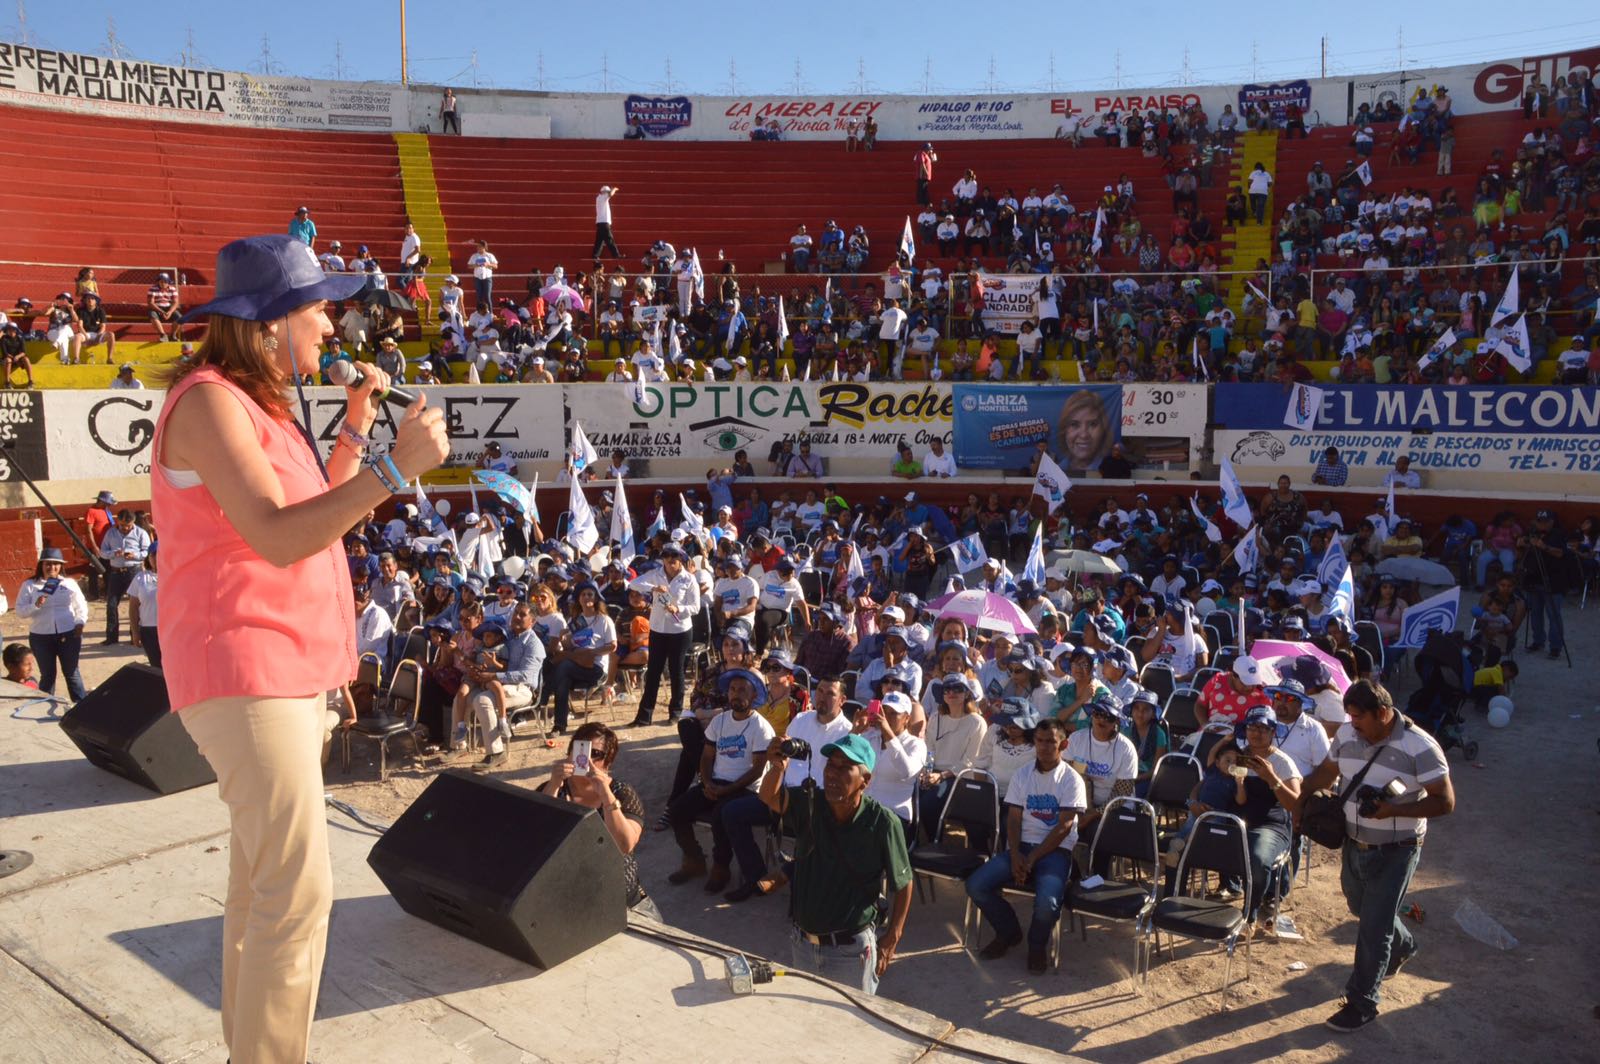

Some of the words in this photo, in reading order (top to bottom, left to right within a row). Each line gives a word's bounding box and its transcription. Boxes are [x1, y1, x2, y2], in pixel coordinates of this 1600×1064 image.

[37, 71, 225, 112] MAQUINARIA
[725, 102, 753, 117] LA
[755, 102, 835, 117] MERA
[838, 101, 883, 117] LEY
[918, 102, 971, 112] HIDALGO
[989, 101, 1014, 112] 106
[1051, 99, 1082, 114] EL
[1095, 93, 1201, 113] PARAISO
[935, 115, 961, 123] ZONA
[964, 114, 998, 123] CENTRO
[632, 385, 811, 419] OPTICA
[978, 394, 1028, 405] LARIZA
[1318, 390, 1363, 425] EL
[1374, 387, 1600, 427] MALECON
[990, 431, 1001, 441] ES
[1003, 429, 1015, 438] DE
[1018, 423, 1049, 436] TODOS
[992, 422, 1018, 432] PIEDRAS
[1019, 418, 1045, 427] NEGRAS
[782, 433, 839, 444] ZARAGOZA
[868, 432, 907, 444] NORTE
[1289, 434, 1403, 448] DISTRIBUIDORA
[1408, 436, 1428, 449] DE
[1434, 436, 1514, 451] PESCADOS
[1518, 438, 1526, 450] Y
[1376, 451, 1396, 465] AL
[1408, 451, 1481, 467] PUBLICO
